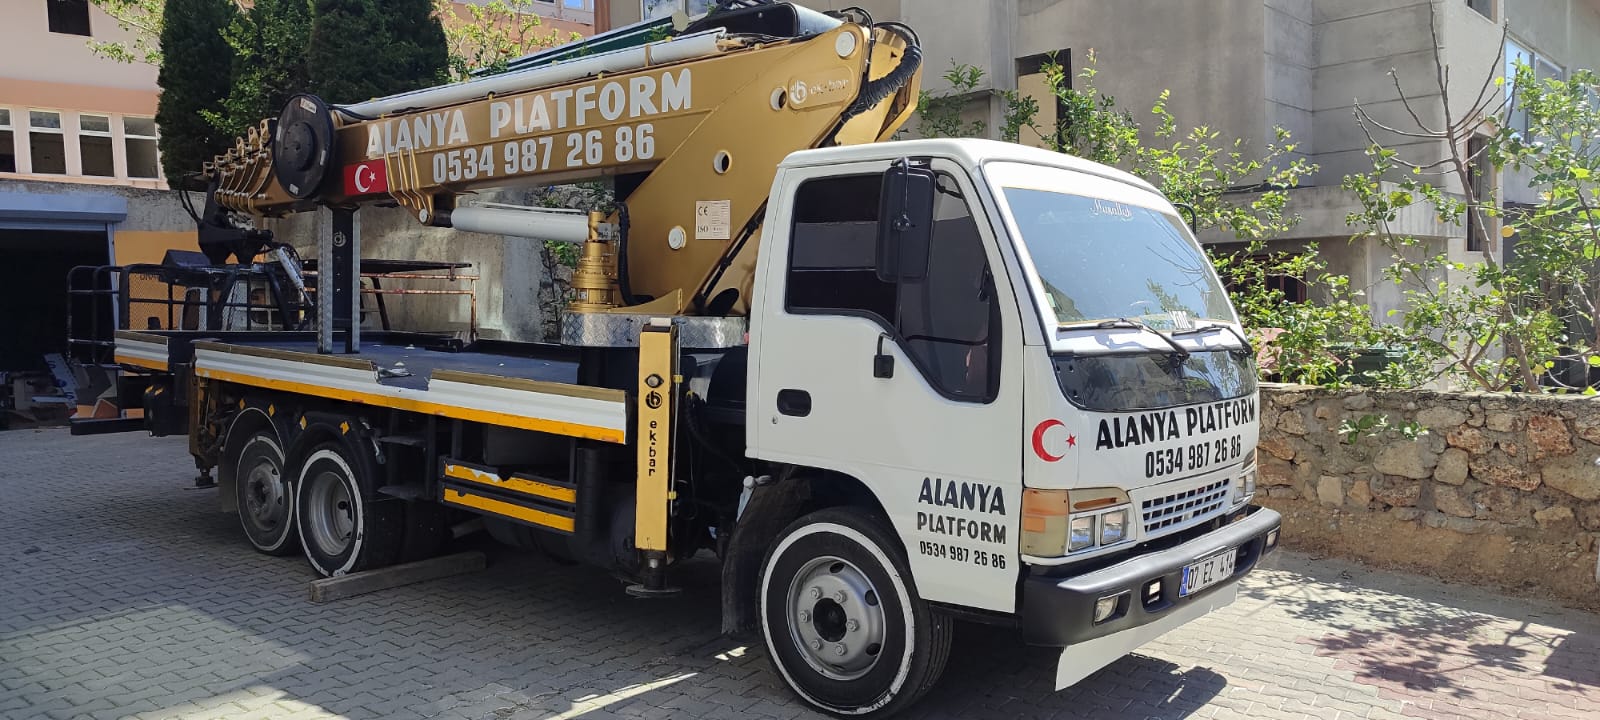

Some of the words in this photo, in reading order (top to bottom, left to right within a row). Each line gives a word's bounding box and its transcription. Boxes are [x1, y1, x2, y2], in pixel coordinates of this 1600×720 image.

[366, 109, 470, 158] ALANYA
[490, 67, 692, 138] PLATFORM
[432, 145, 495, 184] 0534
[504, 136, 554, 174] 987
[566, 131, 603, 168] 26
[615, 123, 656, 162] 86
[697, 225, 709, 233] ISO
[1096, 410, 1180, 450] ALANYA
[1186, 398, 1255, 437] PLATFORM
[1145, 447, 1183, 479] 0534
[1188, 442, 1210, 471] 987
[1214, 438, 1227, 464] 26
[1230, 434, 1241, 459] 86
[918, 477, 1006, 516] ALANYA
[917, 512, 1006, 545] PLATFORM
[919, 541, 947, 559] 0534
[950, 546, 969, 562] 987
[974, 550, 988, 566] 26
[991, 554, 1006, 570] 86
[1187, 566, 1199, 590] 07
[1203, 560, 1215, 585] EZ
